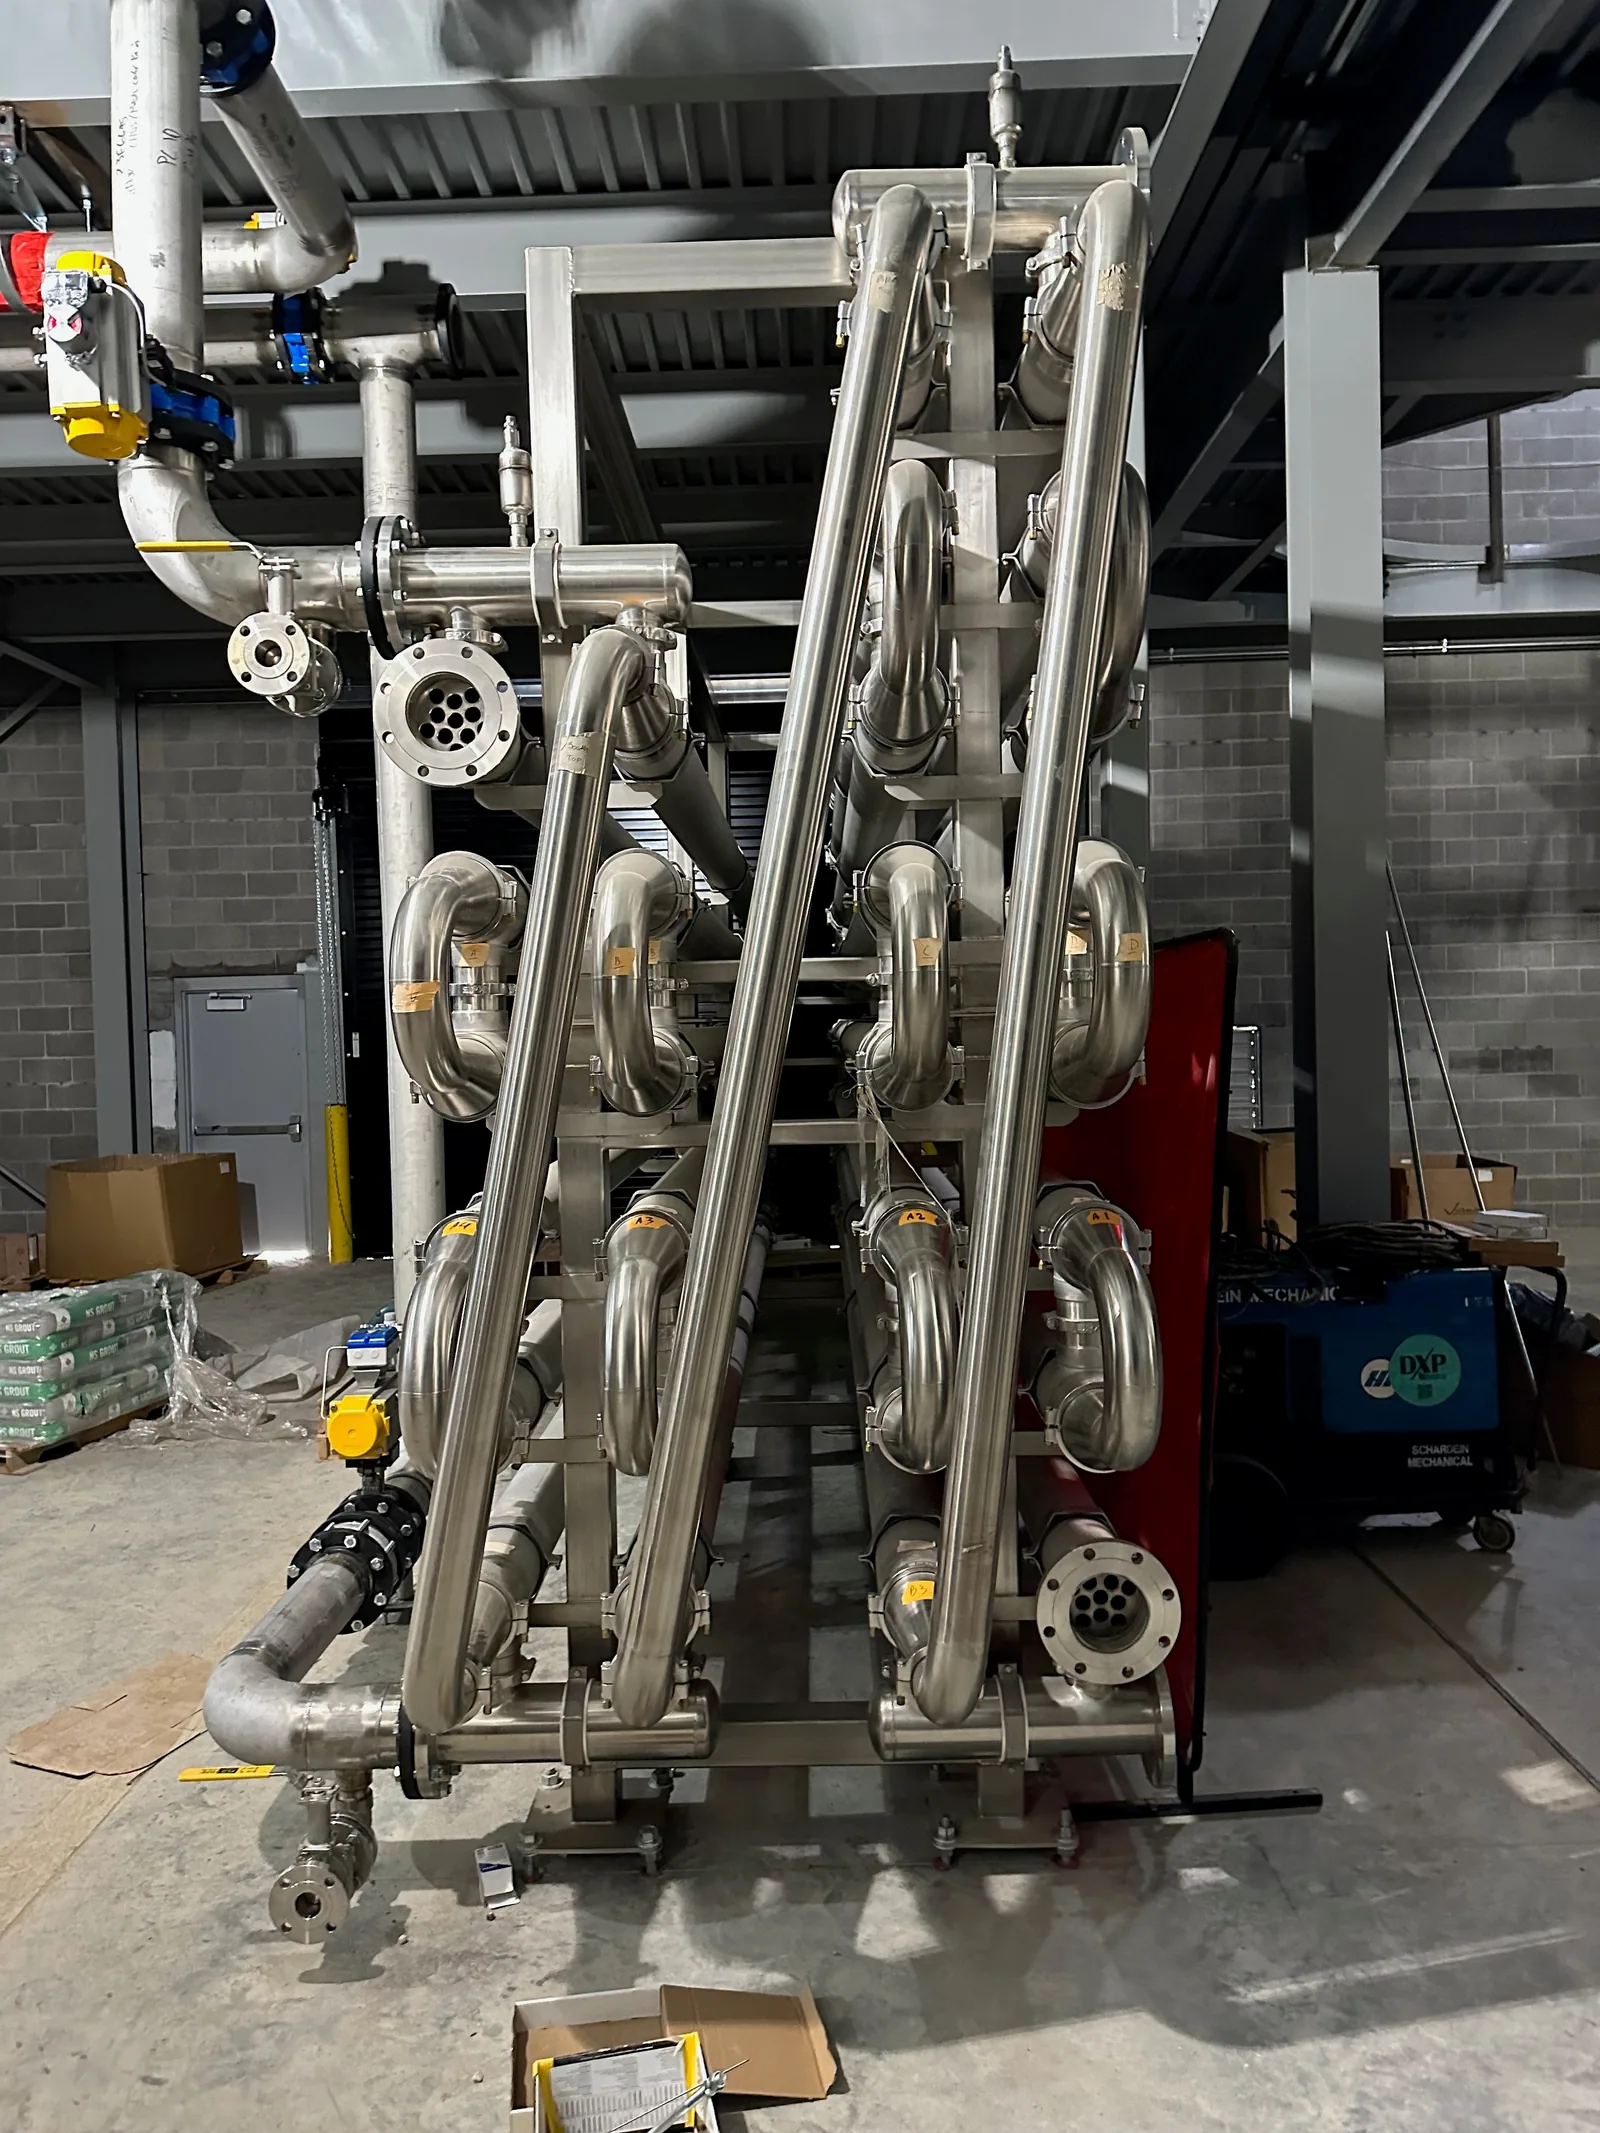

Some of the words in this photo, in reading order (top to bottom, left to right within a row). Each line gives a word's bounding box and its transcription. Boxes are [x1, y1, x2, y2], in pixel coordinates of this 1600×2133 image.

[906, 1212, 926, 1221] A2
[14, 1323, 35, 1332] GROUT
[4, 1344, 30, 1354] GROUT
[1400, 1347, 1447, 1380] DXP
[18, 1365, 40, 1374] GROUT
[4, 1386, 30, 1396] GROUT
[21, 1408, 43, 1418] GROUT
[9, 1427, 36, 1437] GROUT
[1407, 1455, 1473, 1468] MECHANICAL
